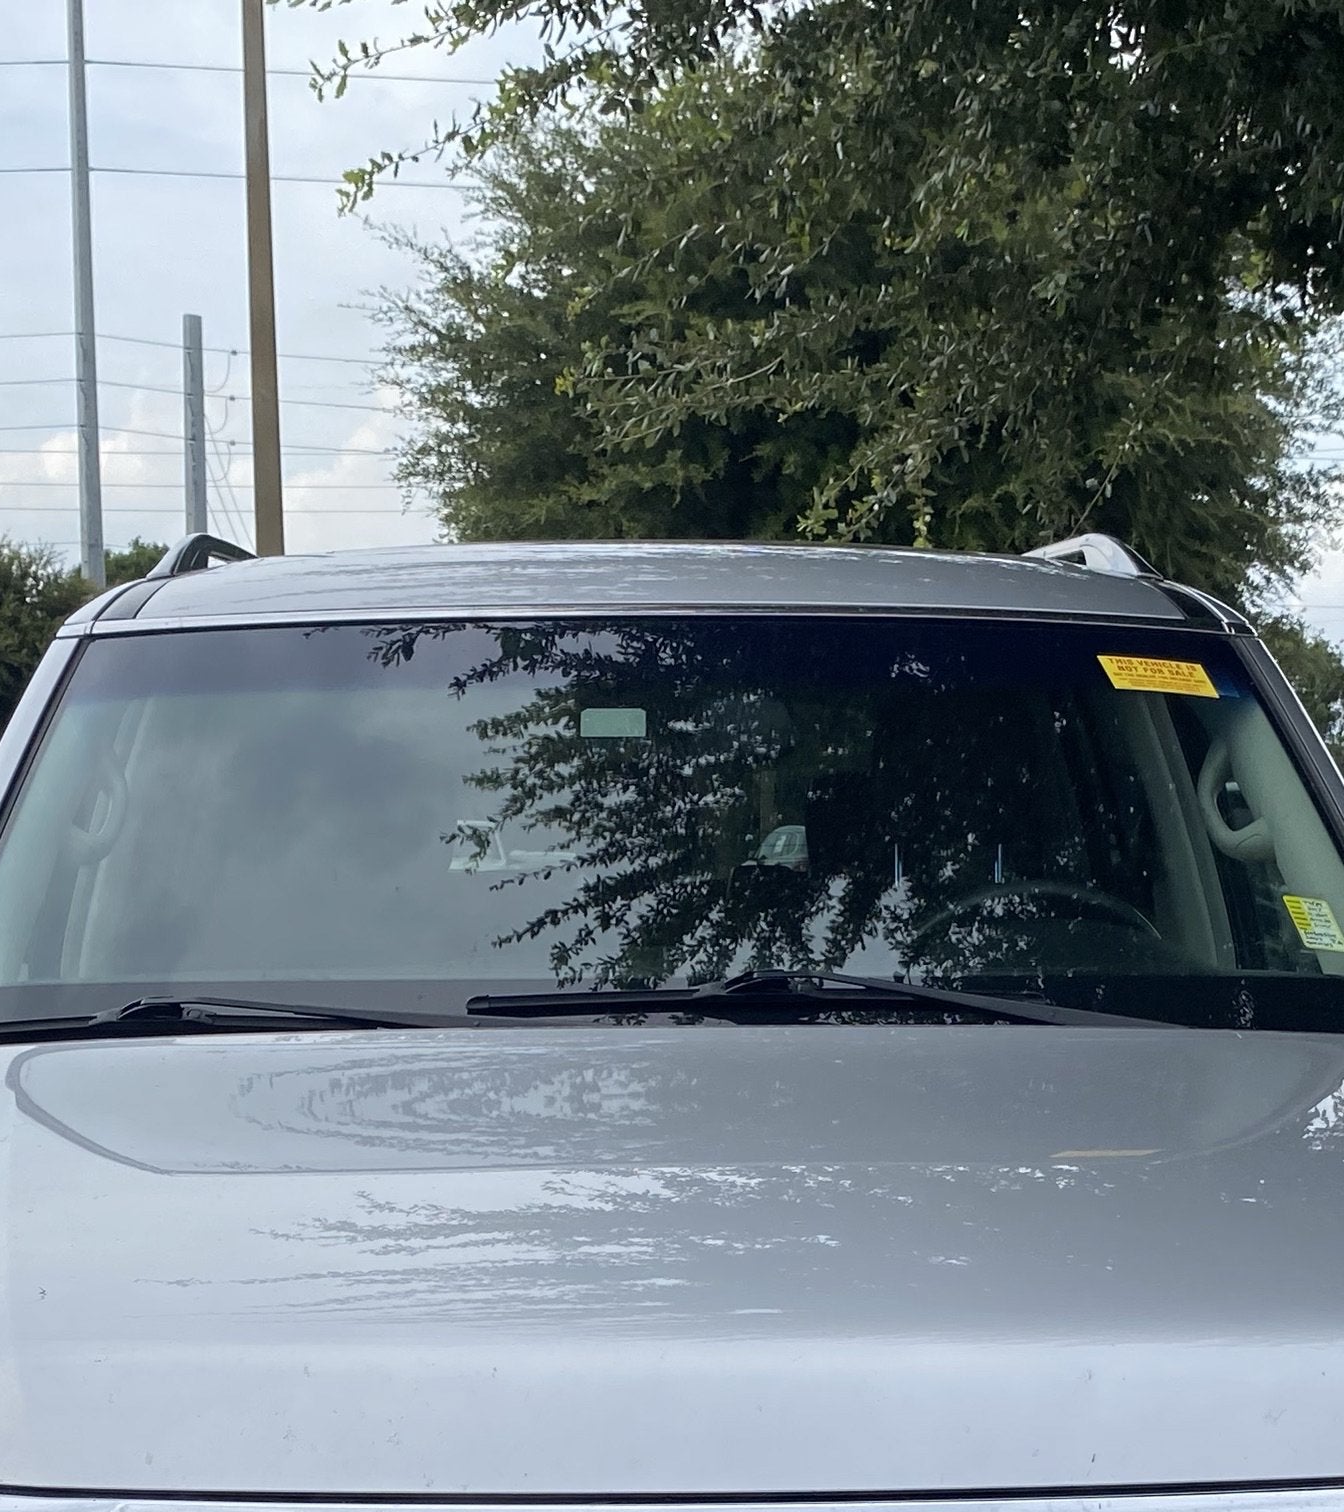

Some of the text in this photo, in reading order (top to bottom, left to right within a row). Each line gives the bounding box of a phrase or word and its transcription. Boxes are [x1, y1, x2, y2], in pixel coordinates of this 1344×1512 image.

[1108, 657, 1197, 672] THIS VEHICLE IS
[1117, 665, 1139, 673] NOT
[1143, 667, 1165, 675] FOR
[1168, 669, 1196, 678] SALE
